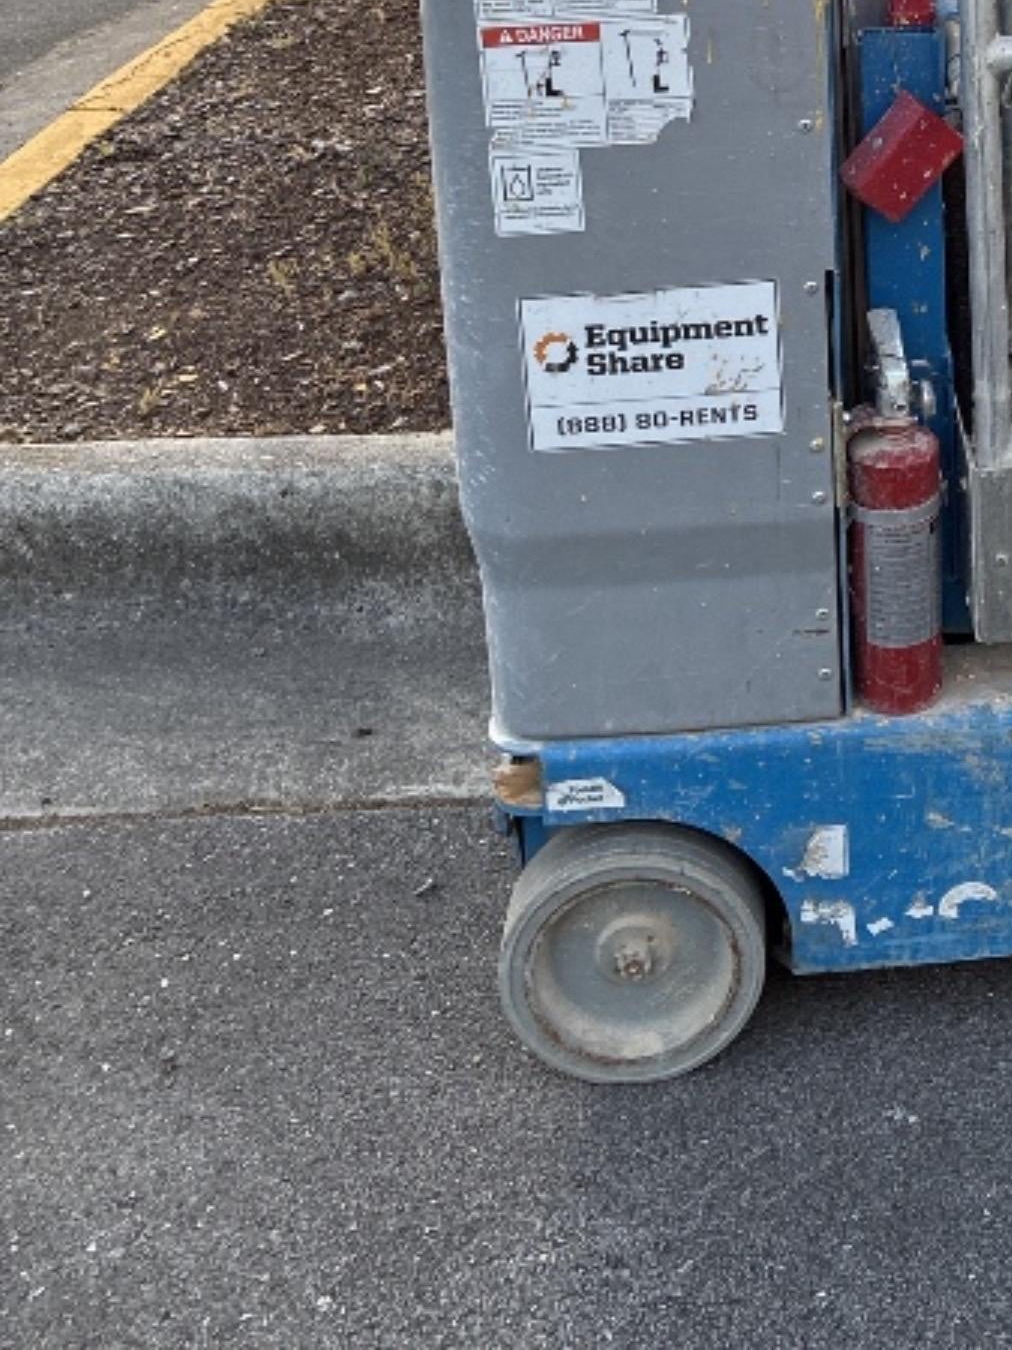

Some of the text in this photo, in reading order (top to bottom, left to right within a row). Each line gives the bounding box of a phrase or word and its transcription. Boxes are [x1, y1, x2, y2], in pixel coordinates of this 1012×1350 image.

[515, 25, 583, 42] DANGER
[584, 314, 768, 351] Equipment
[586, 352, 685, 375] Share
[557, 404, 758, 436] (888) 80-RENTS
